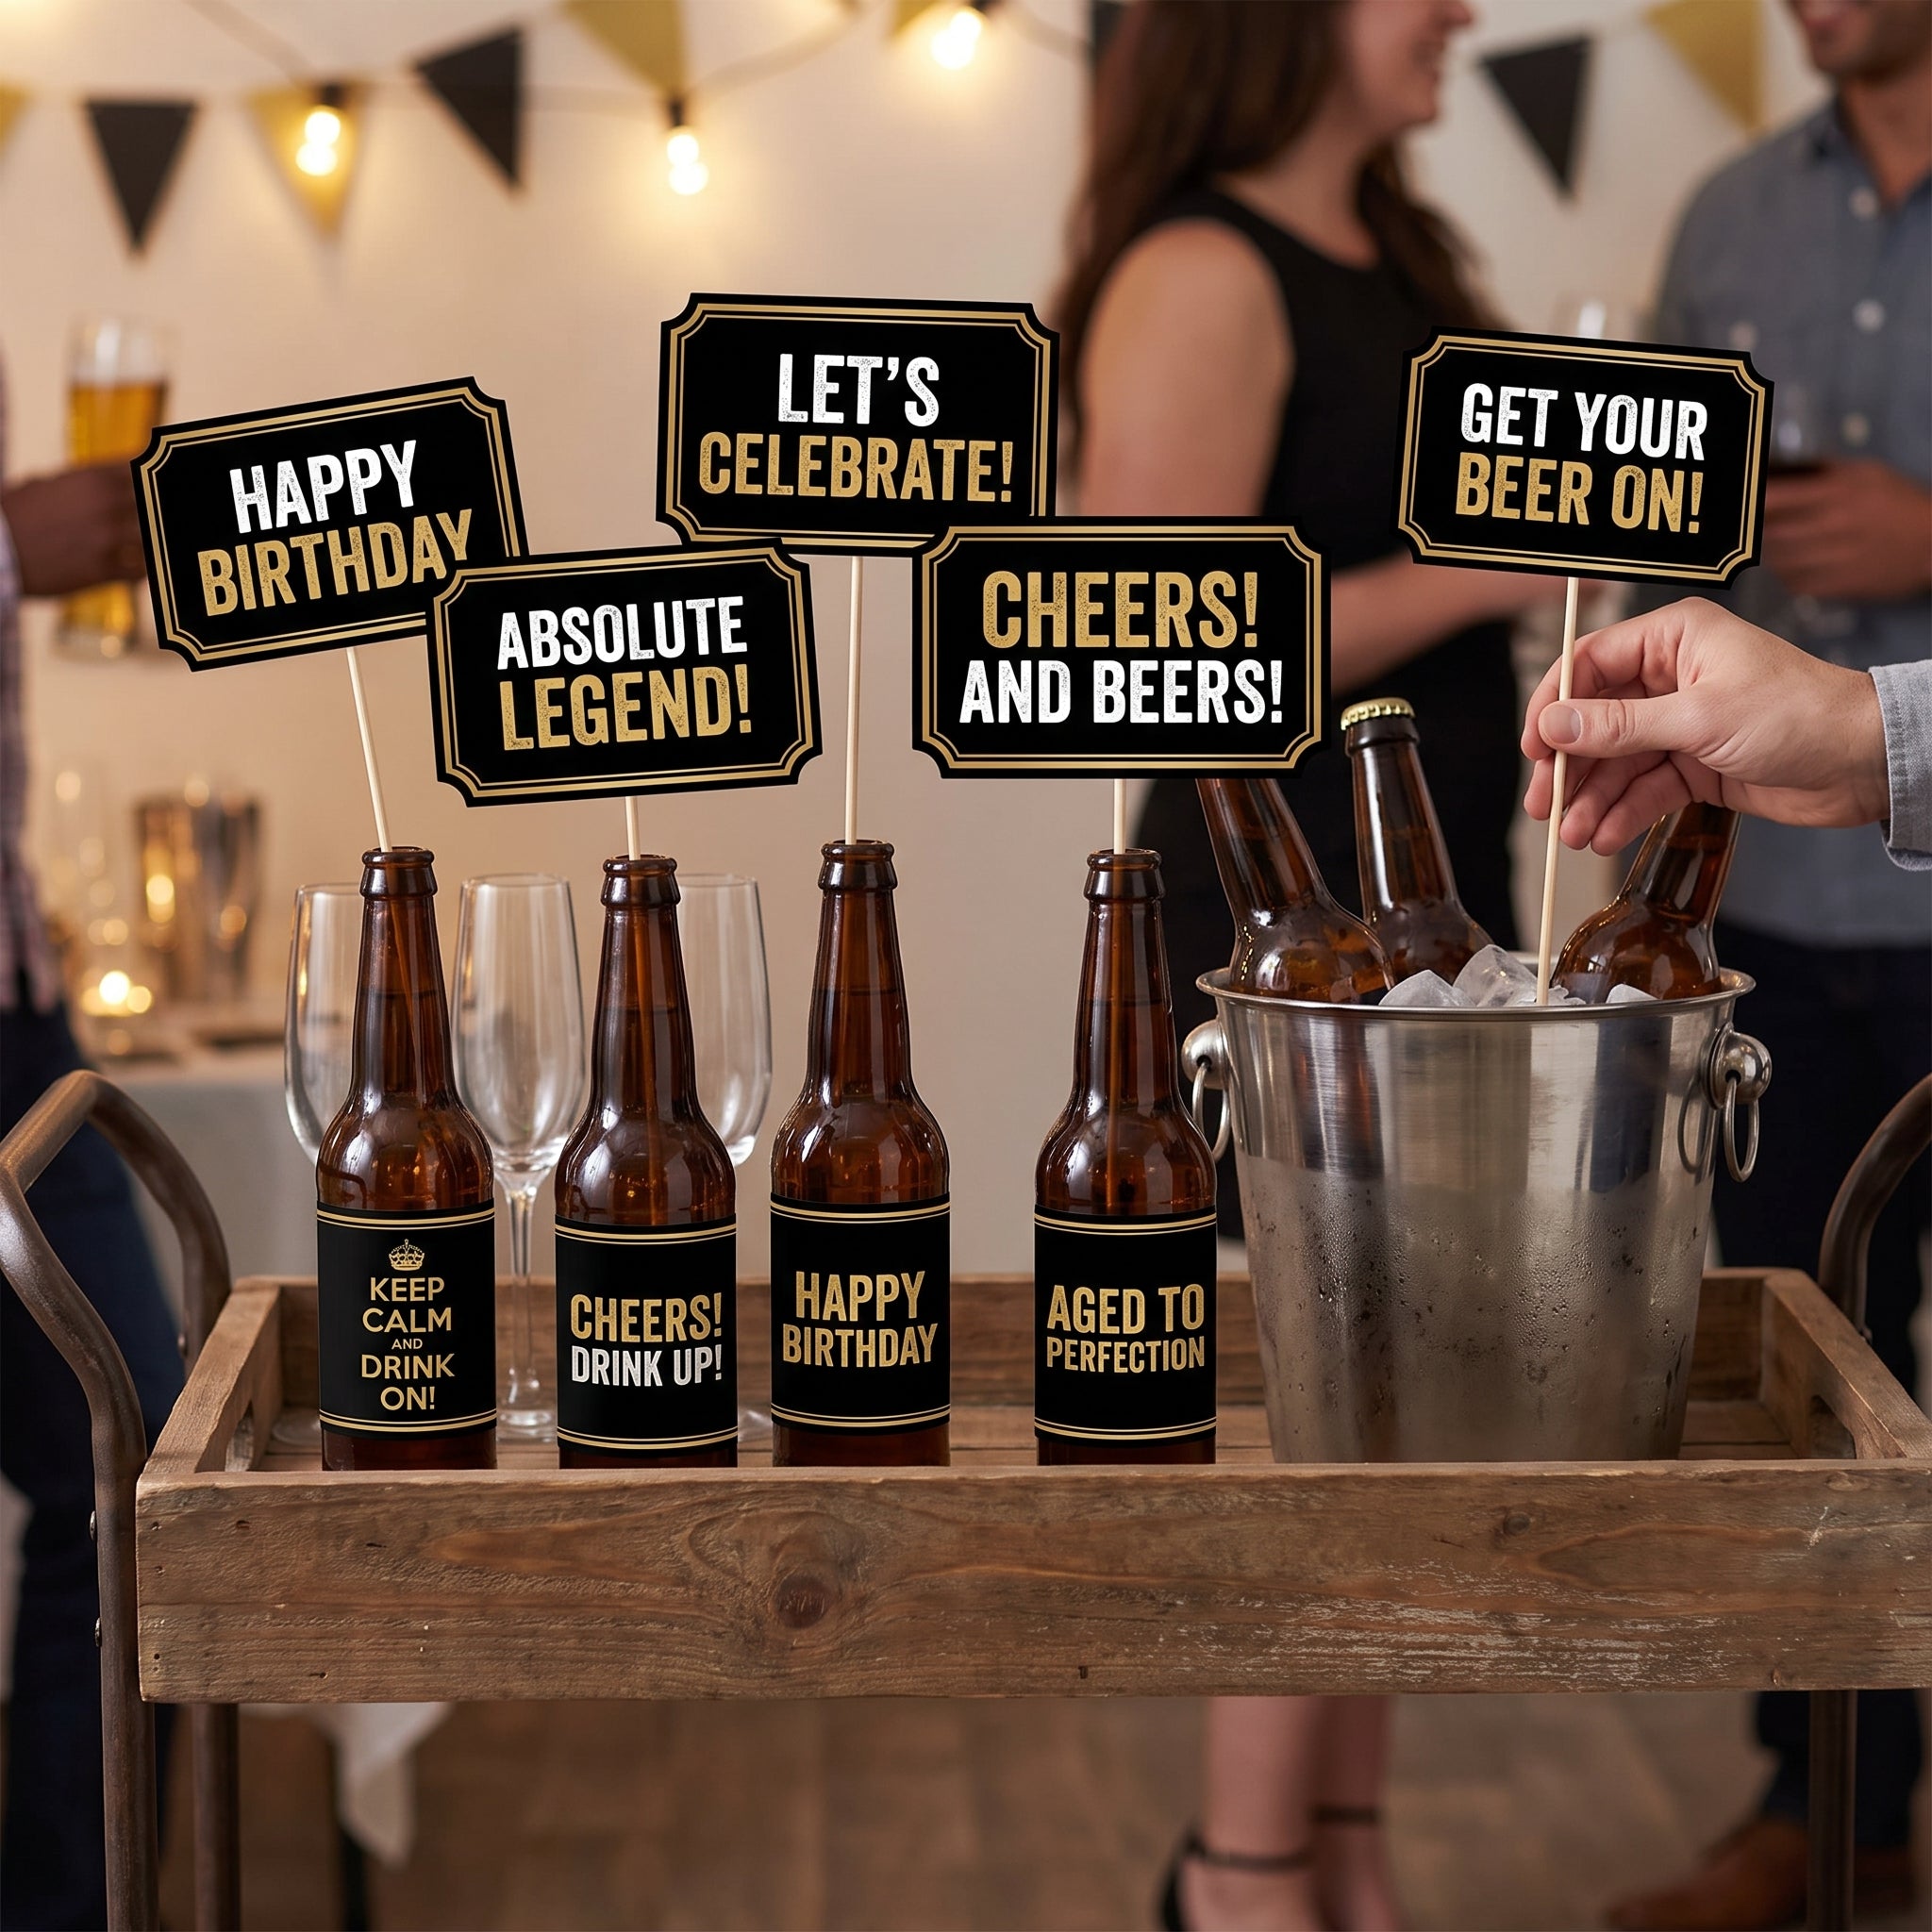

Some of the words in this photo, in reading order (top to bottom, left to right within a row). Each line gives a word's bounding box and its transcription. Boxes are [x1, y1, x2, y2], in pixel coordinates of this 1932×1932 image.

[778, 354, 939, 426] LET'S
[1461, 383, 1558, 447] GET
[1574, 392, 1707, 460] YOUR
[230, 440, 416, 533] HAPPY
[700, 432, 1013, 502] CELEBRATE!
[1456, 452, 1592, 525] BEER
[1611, 465, 1703, 533] ON!
[198, 508, 472, 616] BIRTHDAY
[497, 596, 747, 670] ABSOLUTE
[983, 571, 1257, 648] CHEERS!
[500, 664, 751, 750] LEGEND!
[959, 660, 1071, 723] AND
[1093, 659, 1282, 724] BEERS!
[370, 1276, 445, 1302] KEEP
[795, 1270, 925, 1322] HAPPY
[1046, 1284, 1146, 1335] AGED
[1158, 1283, 1205, 1333] TO
[362, 1307, 452, 1333] CALM
[570, 1291, 722, 1343] CHEERS!
[361, 1353, 456, 1380] DRINK
[391, 1338, 424, 1350] AND
[571, 1344, 663, 1387] DRINK
[673, 1343, 722, 1386] UP!
[782, 1323, 939, 1368] BIRTHDAY
[1046, 1335, 1205, 1374] PERFECTION
[380, 1386, 436, 1411] ON!
